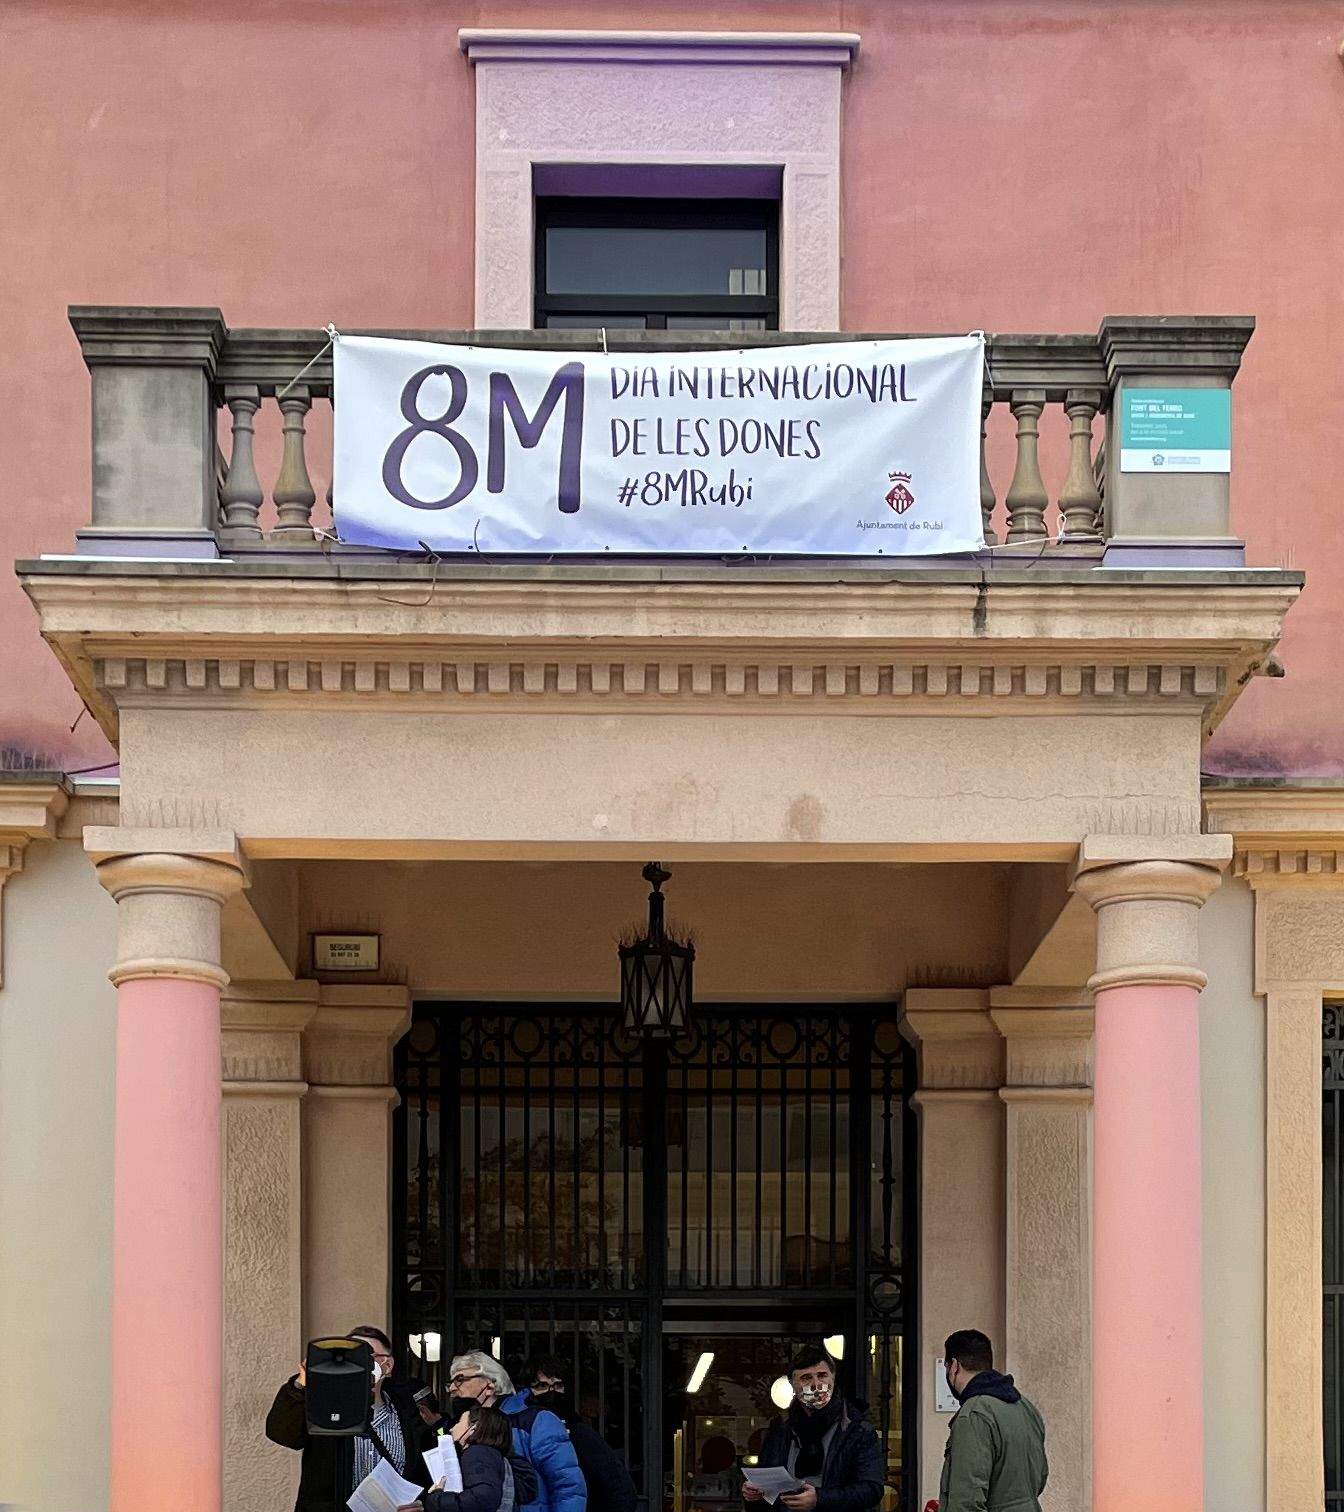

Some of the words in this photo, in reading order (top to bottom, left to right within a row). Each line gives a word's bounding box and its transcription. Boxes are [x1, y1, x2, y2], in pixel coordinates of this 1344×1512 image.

[668, 361, 918, 403] INTERNACIONAL
[382, 361, 585, 514] 8M
[611, 418, 648, 458] DE
[657, 417, 711, 457] LES
[719, 418, 822, 459] DONES
